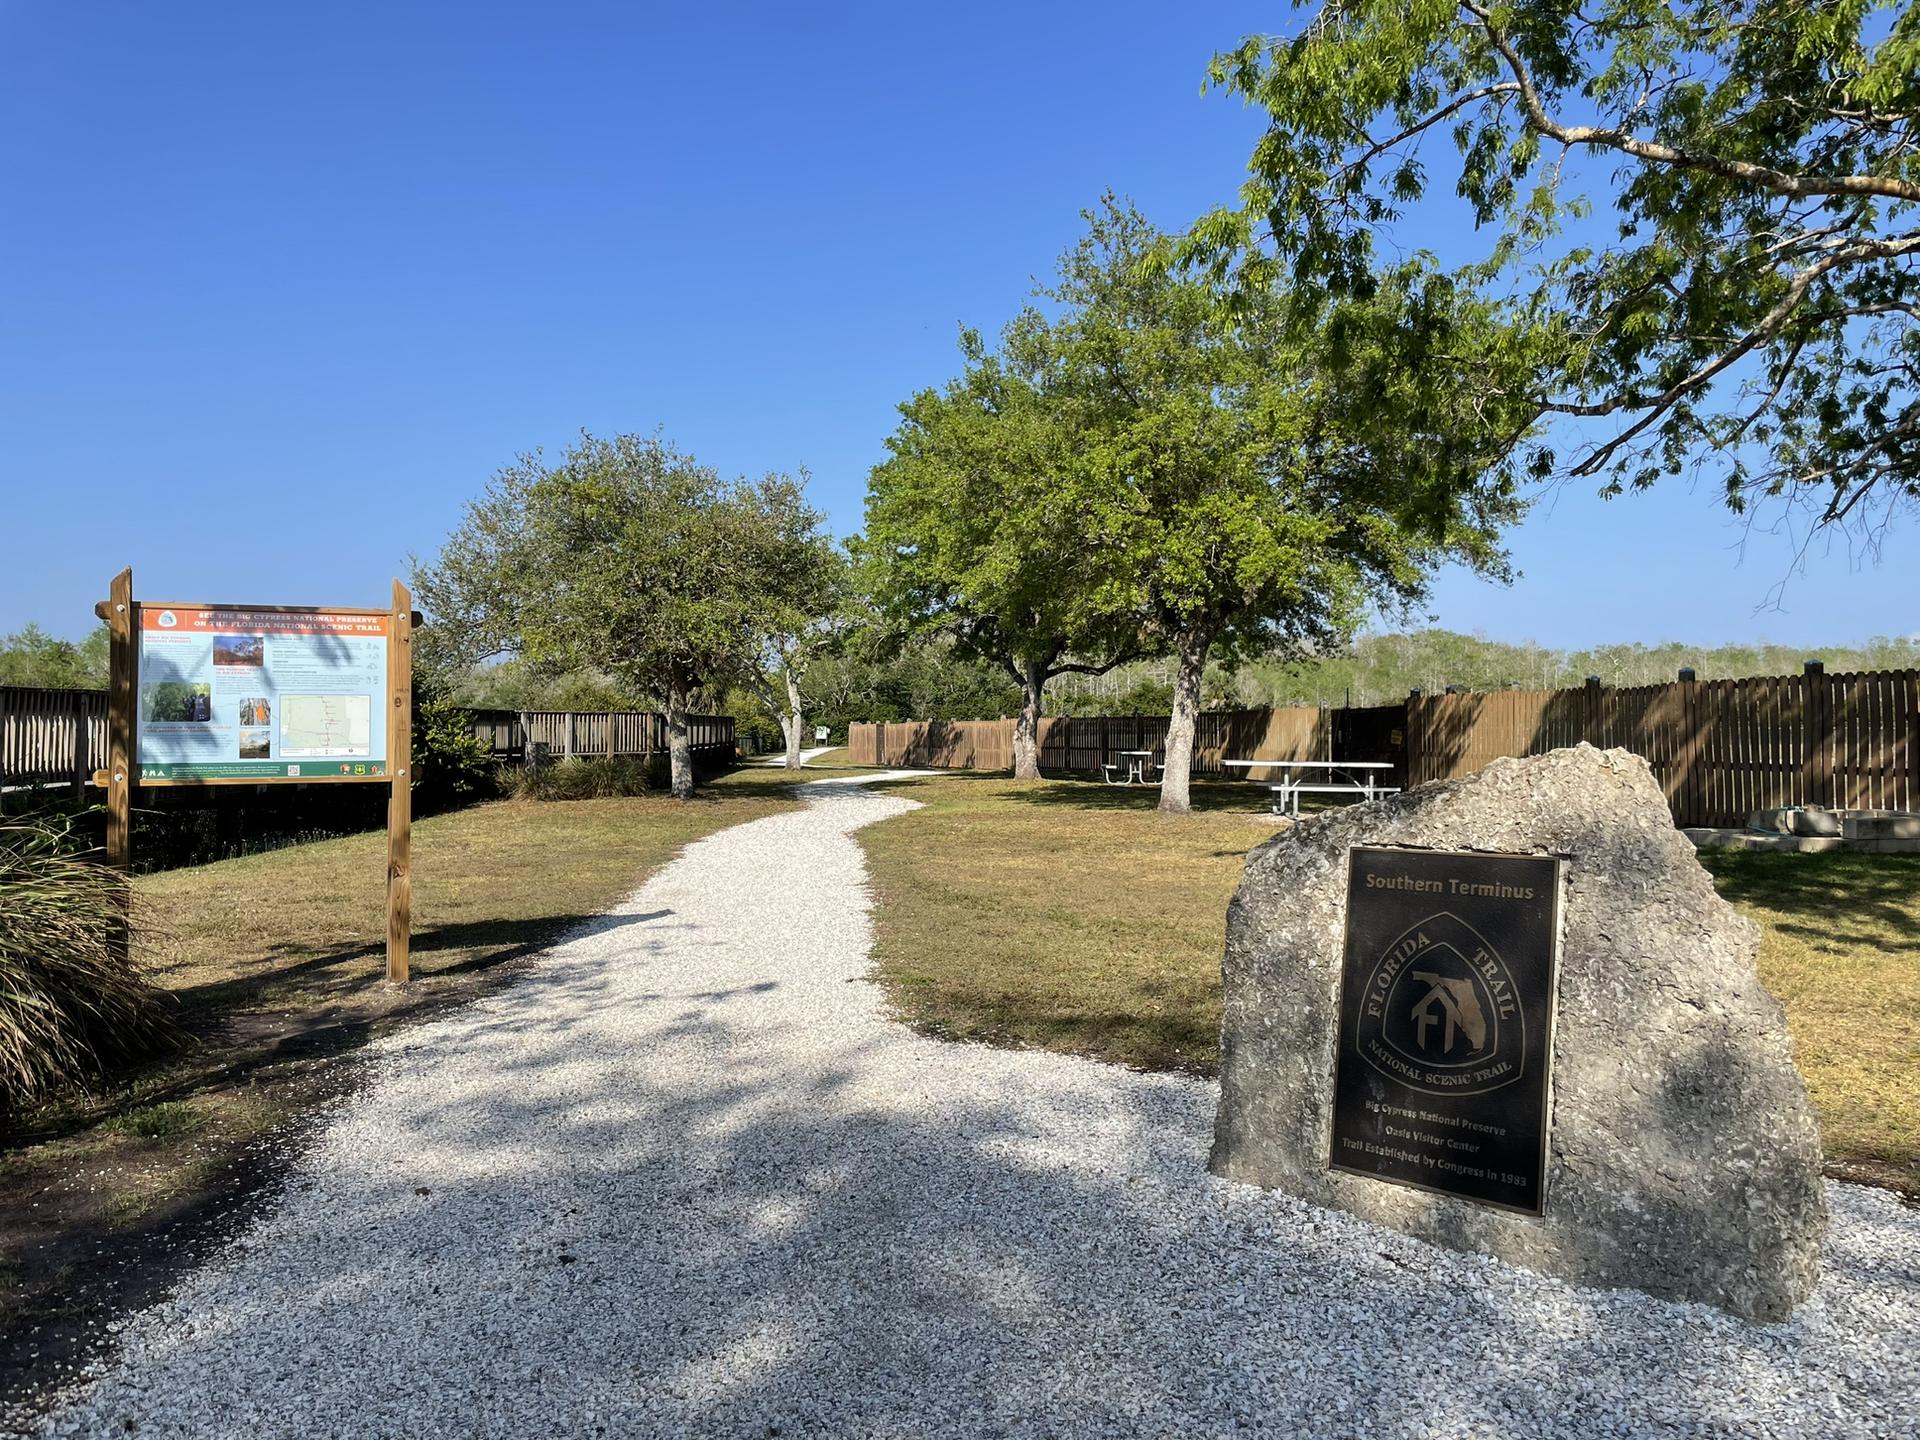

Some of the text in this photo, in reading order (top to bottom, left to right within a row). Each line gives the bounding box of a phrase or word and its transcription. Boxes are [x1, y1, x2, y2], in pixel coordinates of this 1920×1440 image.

[273, 622, 318, 630] NATIONAL
[355, 624, 382, 632] TRAIL
[1366, 872, 1535, 900] Southern Terminus
[1367, 931, 1516, 1020] FLORIDA TRAIL
[1368, 1039, 1513, 1086] NATIONAL SCENIC TRAIL
[1365, 1100, 1506, 1136] Big Cypress National Preserve
[1385, 1125, 1480, 1153] Oasis Visitor Center
[1342, 1137, 1528, 1187] Trail Established by Congress in 1983
